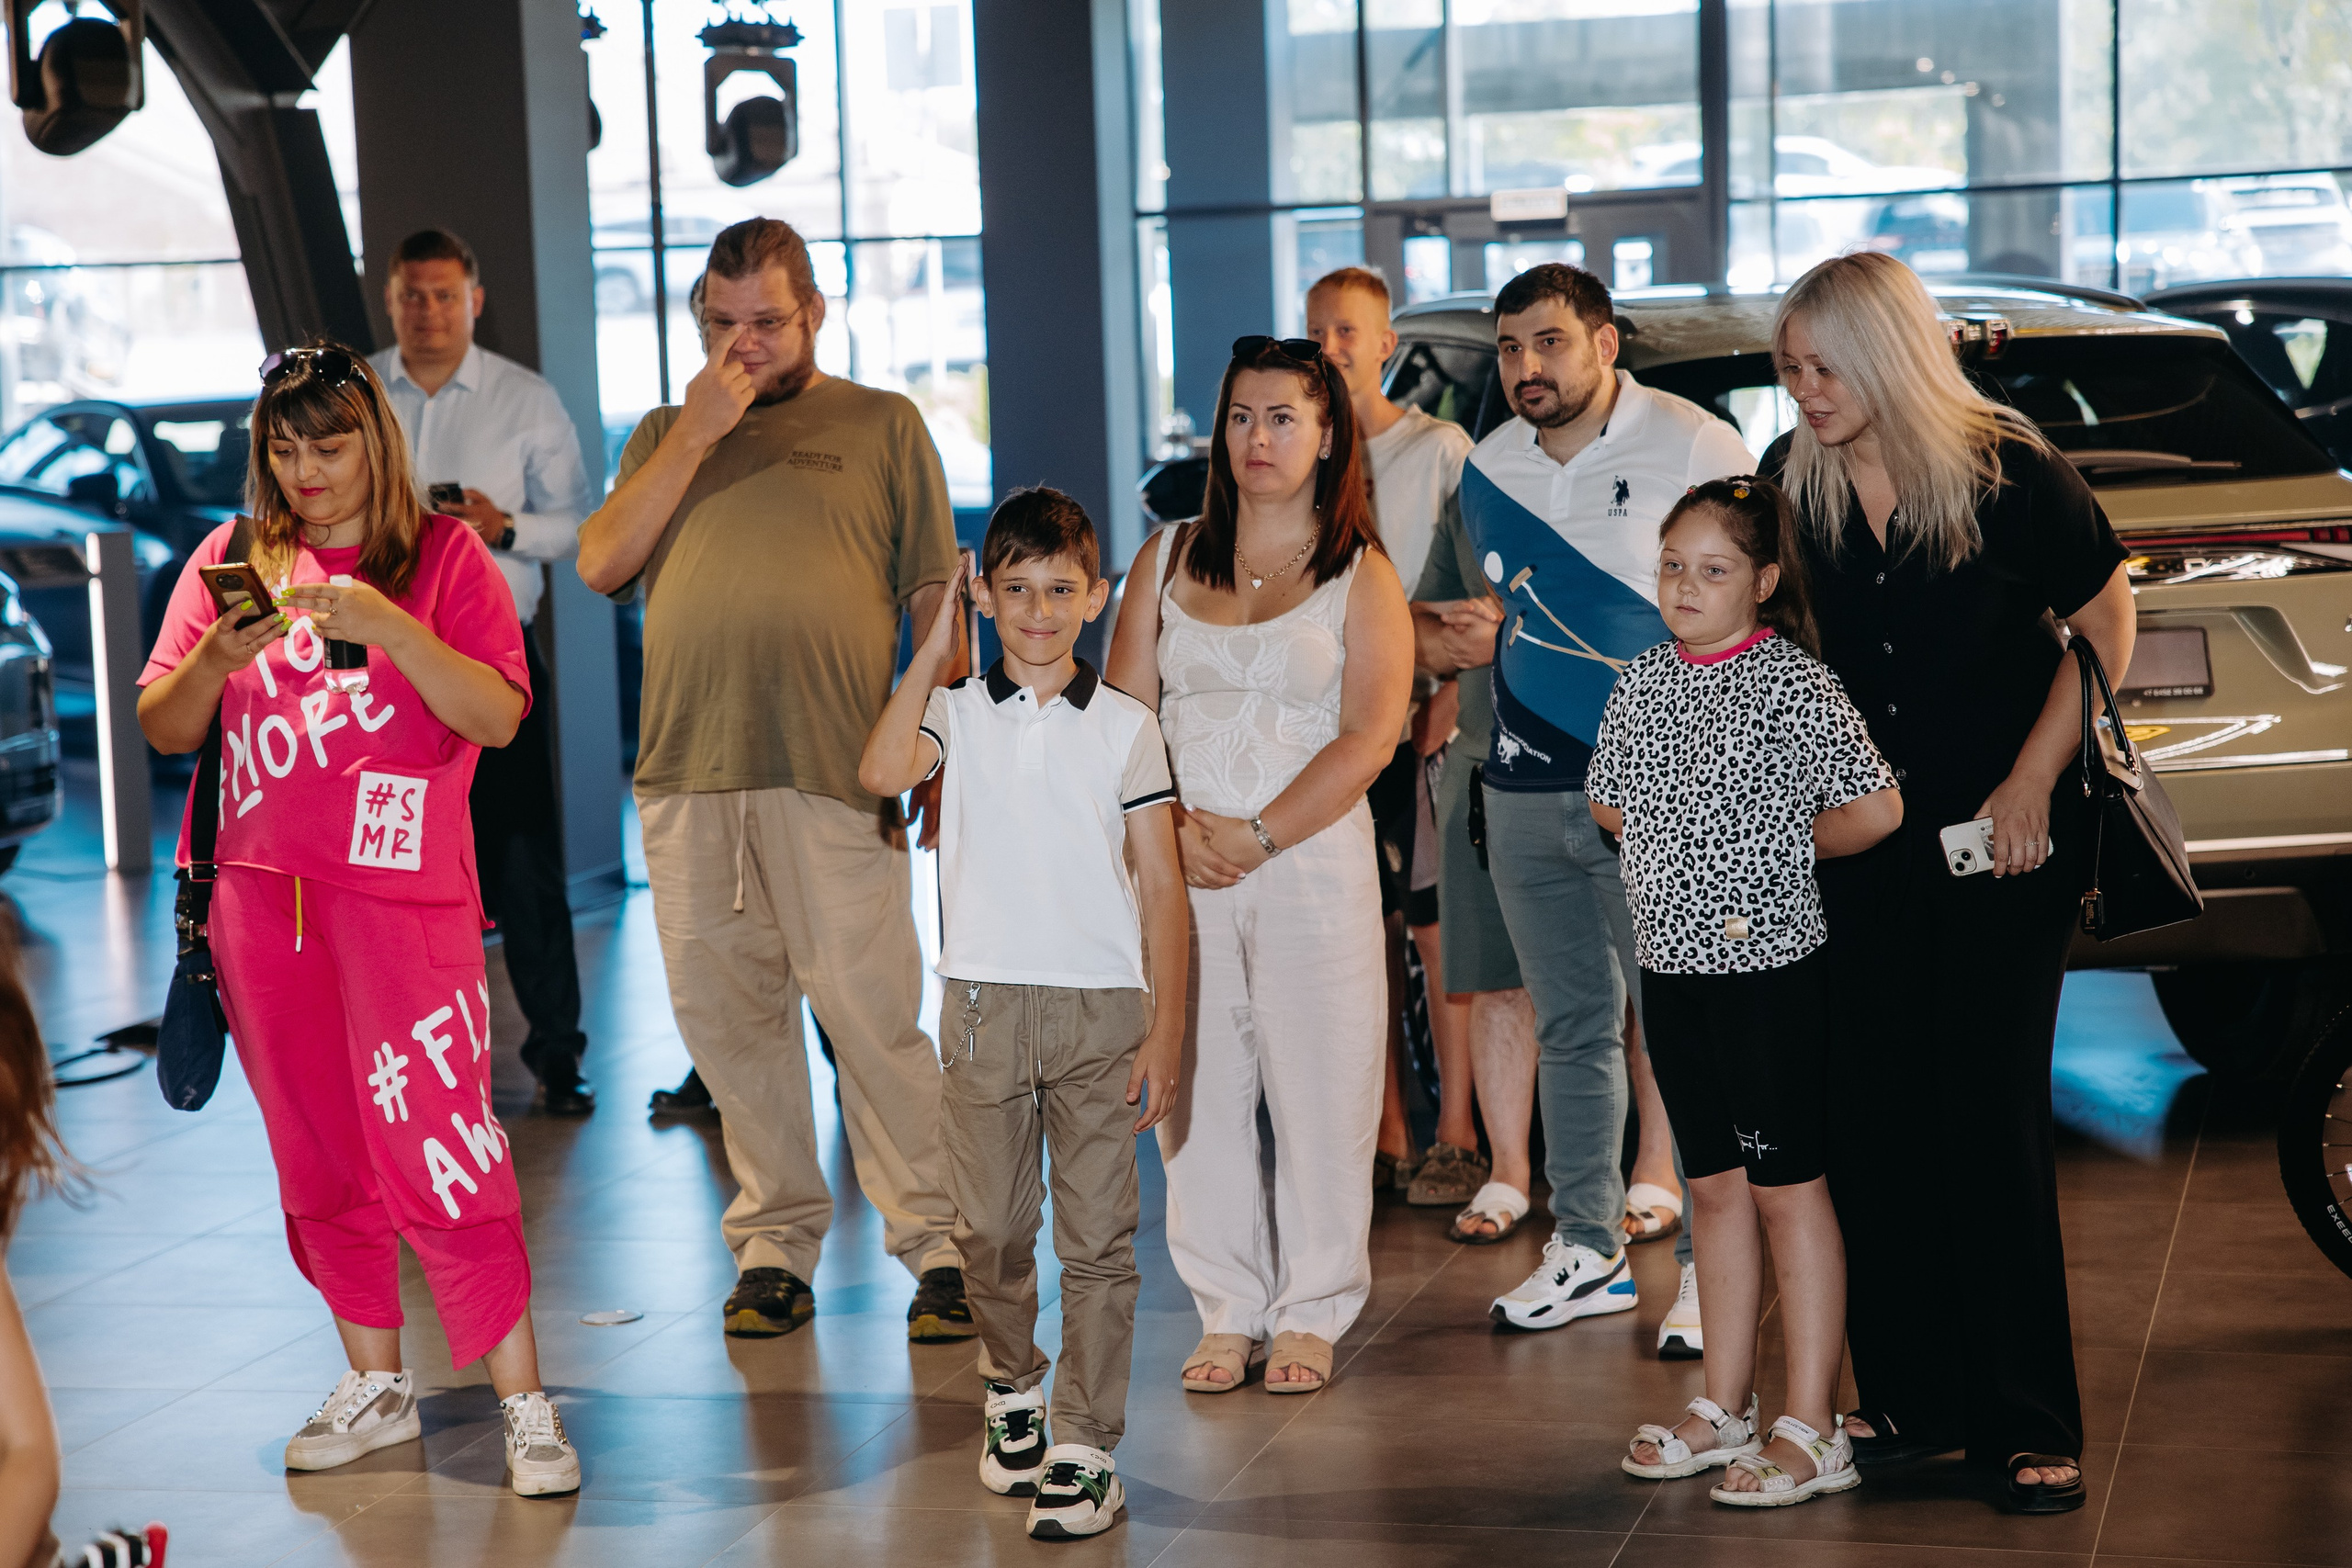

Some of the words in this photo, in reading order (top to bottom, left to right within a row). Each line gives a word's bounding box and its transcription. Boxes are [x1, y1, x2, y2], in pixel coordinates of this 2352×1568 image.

[786, 458, 843, 472] ADVENTURE
[792, 451, 821, 460] READY
[823, 454, 842, 463] FOR
[365, 783, 416, 822] #S
[358, 823, 413, 860] MR
